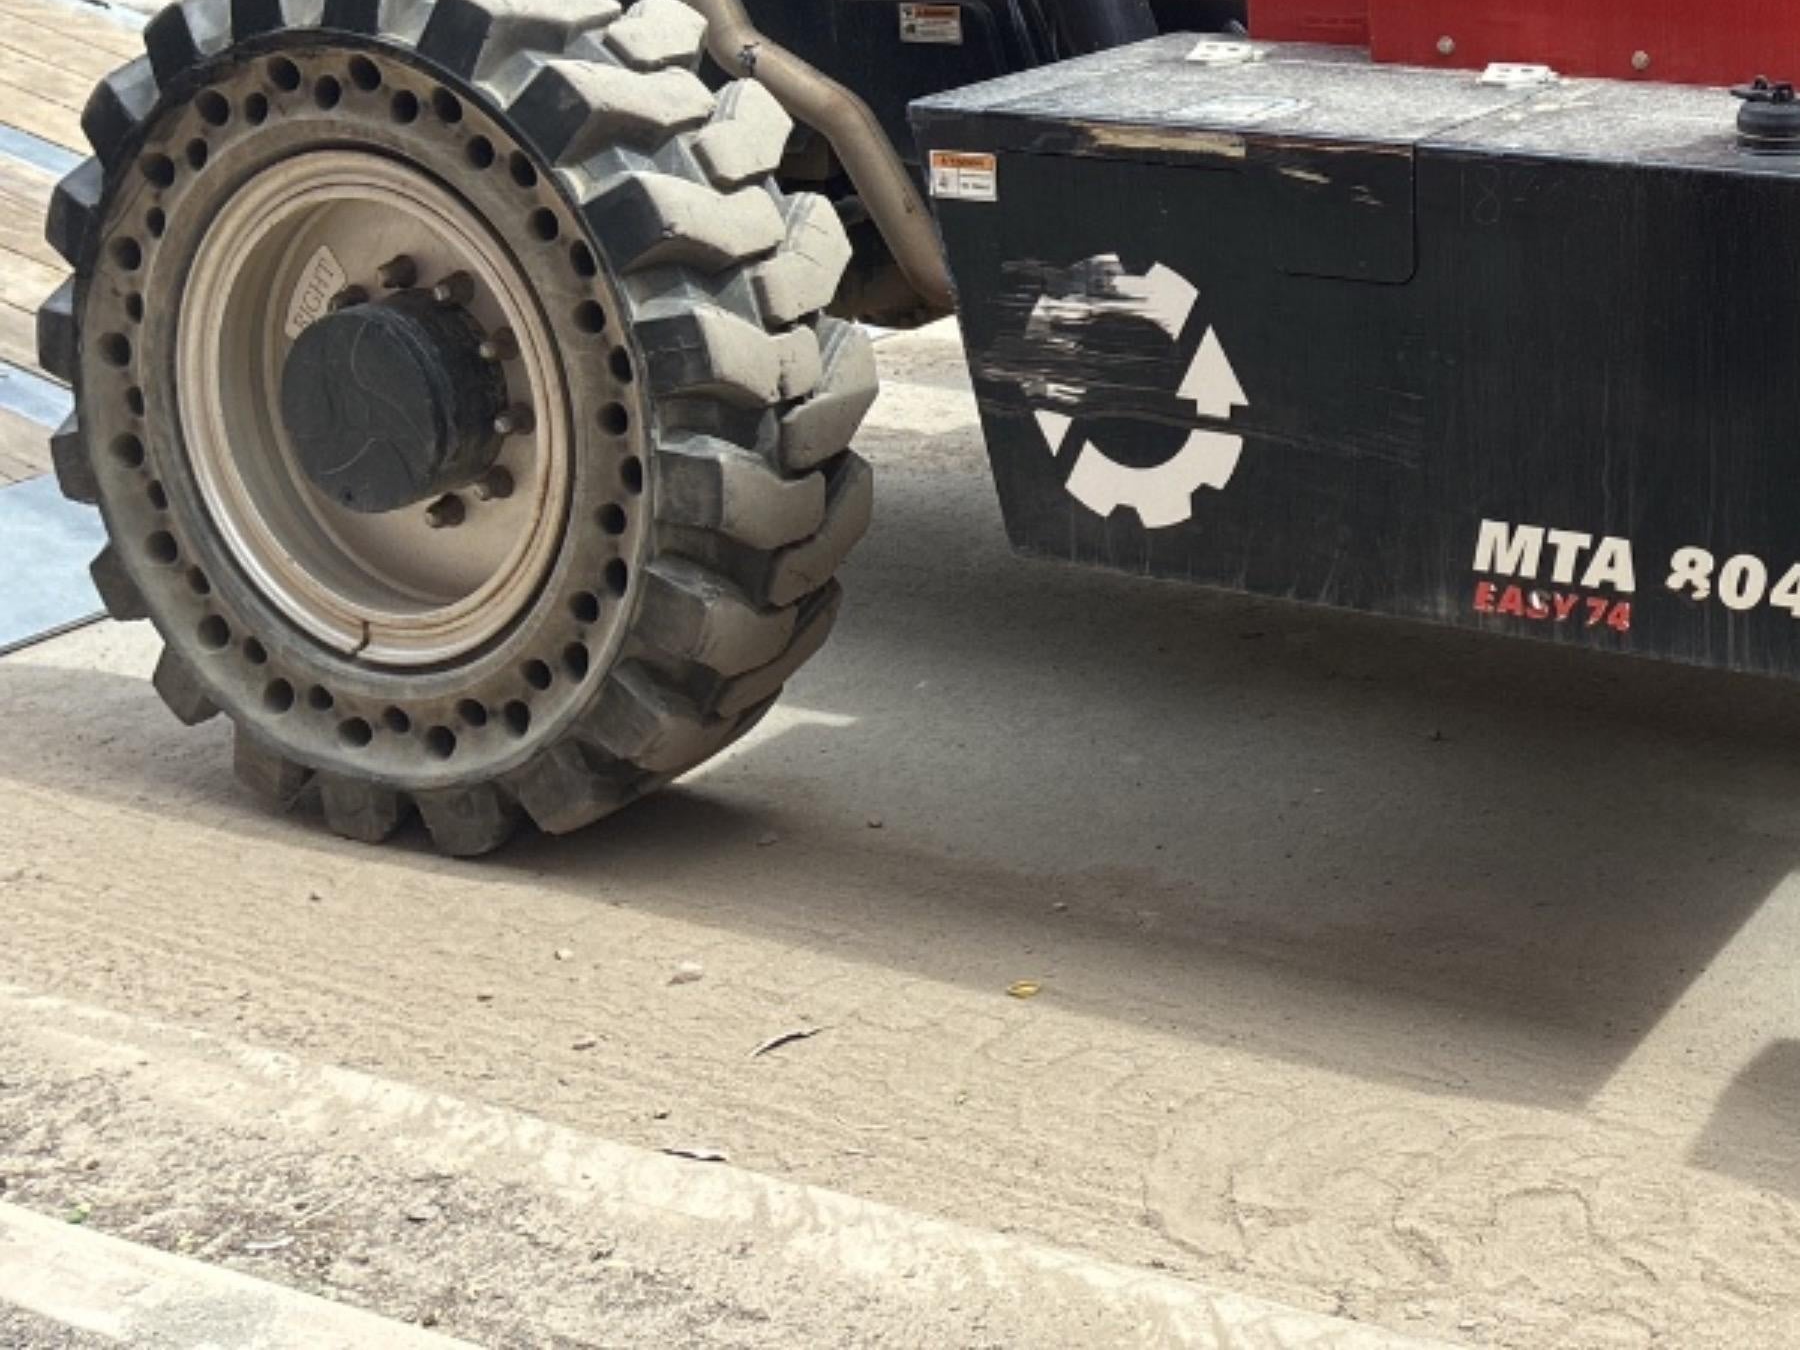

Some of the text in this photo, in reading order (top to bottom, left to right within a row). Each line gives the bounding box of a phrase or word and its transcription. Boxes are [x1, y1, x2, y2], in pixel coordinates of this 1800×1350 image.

[294, 258, 335, 329] RIGHT
[1472, 518, 1637, 592] MTA
[1472, 581, 1632, 633] EASY 74
